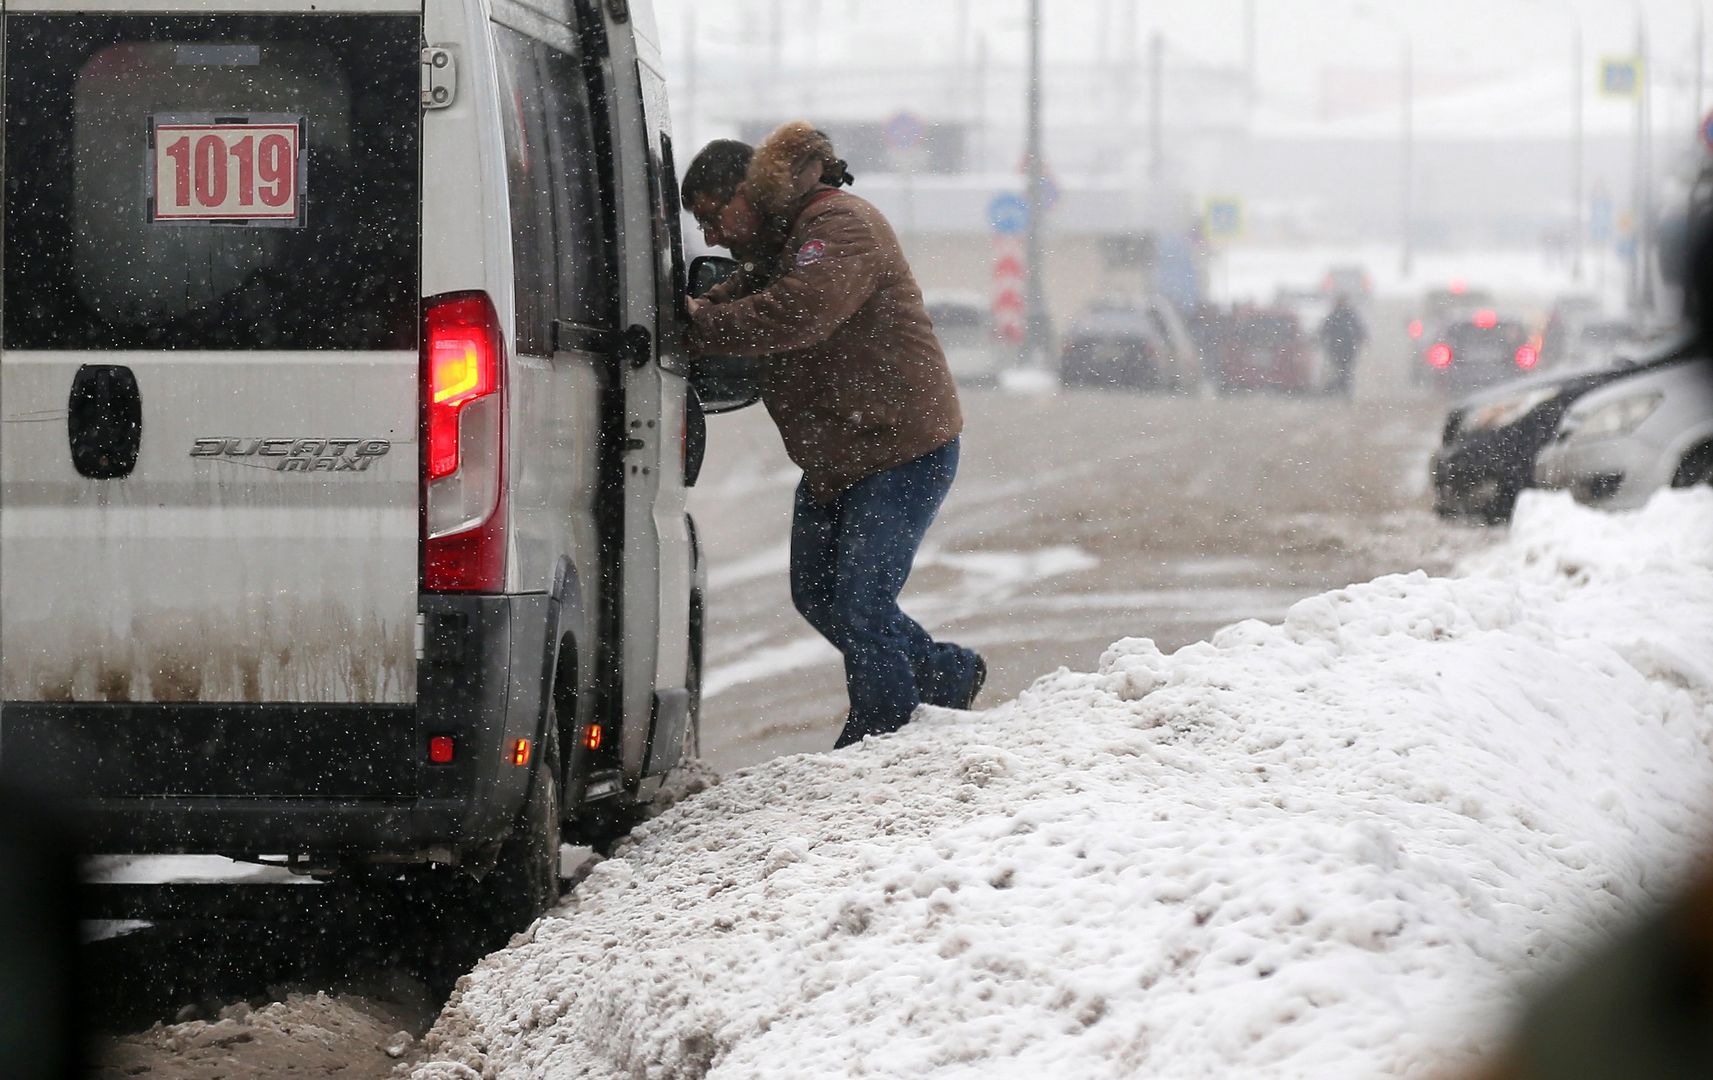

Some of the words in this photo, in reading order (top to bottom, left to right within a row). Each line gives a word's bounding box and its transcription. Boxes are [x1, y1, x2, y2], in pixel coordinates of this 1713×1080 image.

[166, 133, 292, 207] 1019
[189, 437, 391, 457] DUCATO
[276, 455, 373, 472] MAXI
